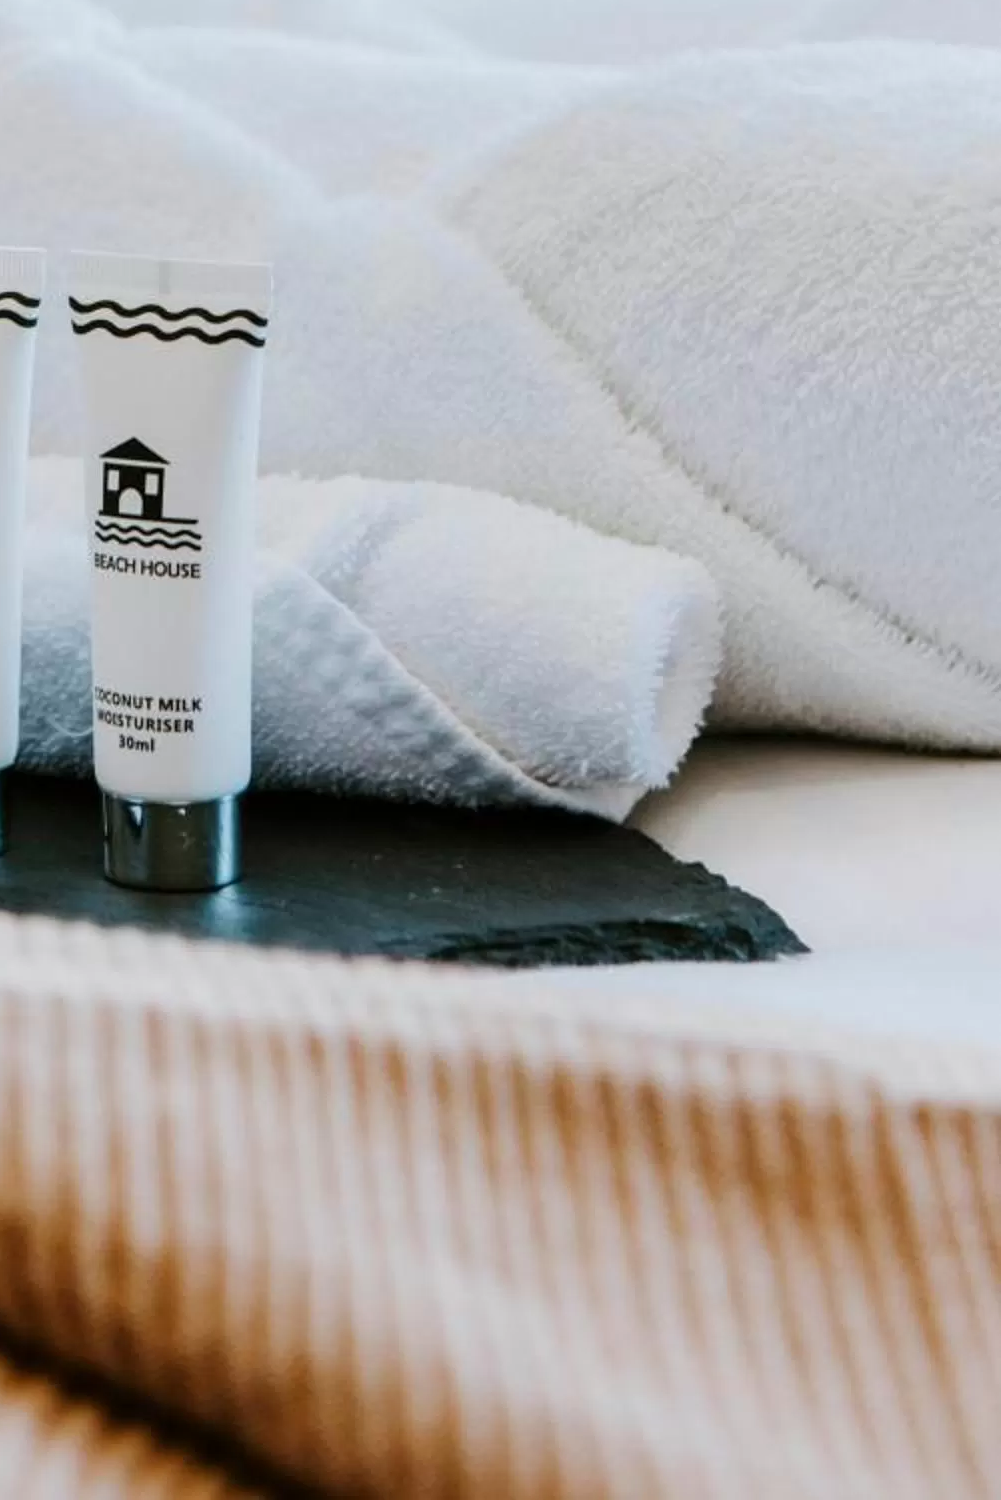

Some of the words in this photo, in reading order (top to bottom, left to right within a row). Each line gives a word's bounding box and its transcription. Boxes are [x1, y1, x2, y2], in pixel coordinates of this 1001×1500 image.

[141, 560, 200, 578] HOUSE
[158, 698, 202, 712] MILK
[119, 734, 155, 752] 30ml
